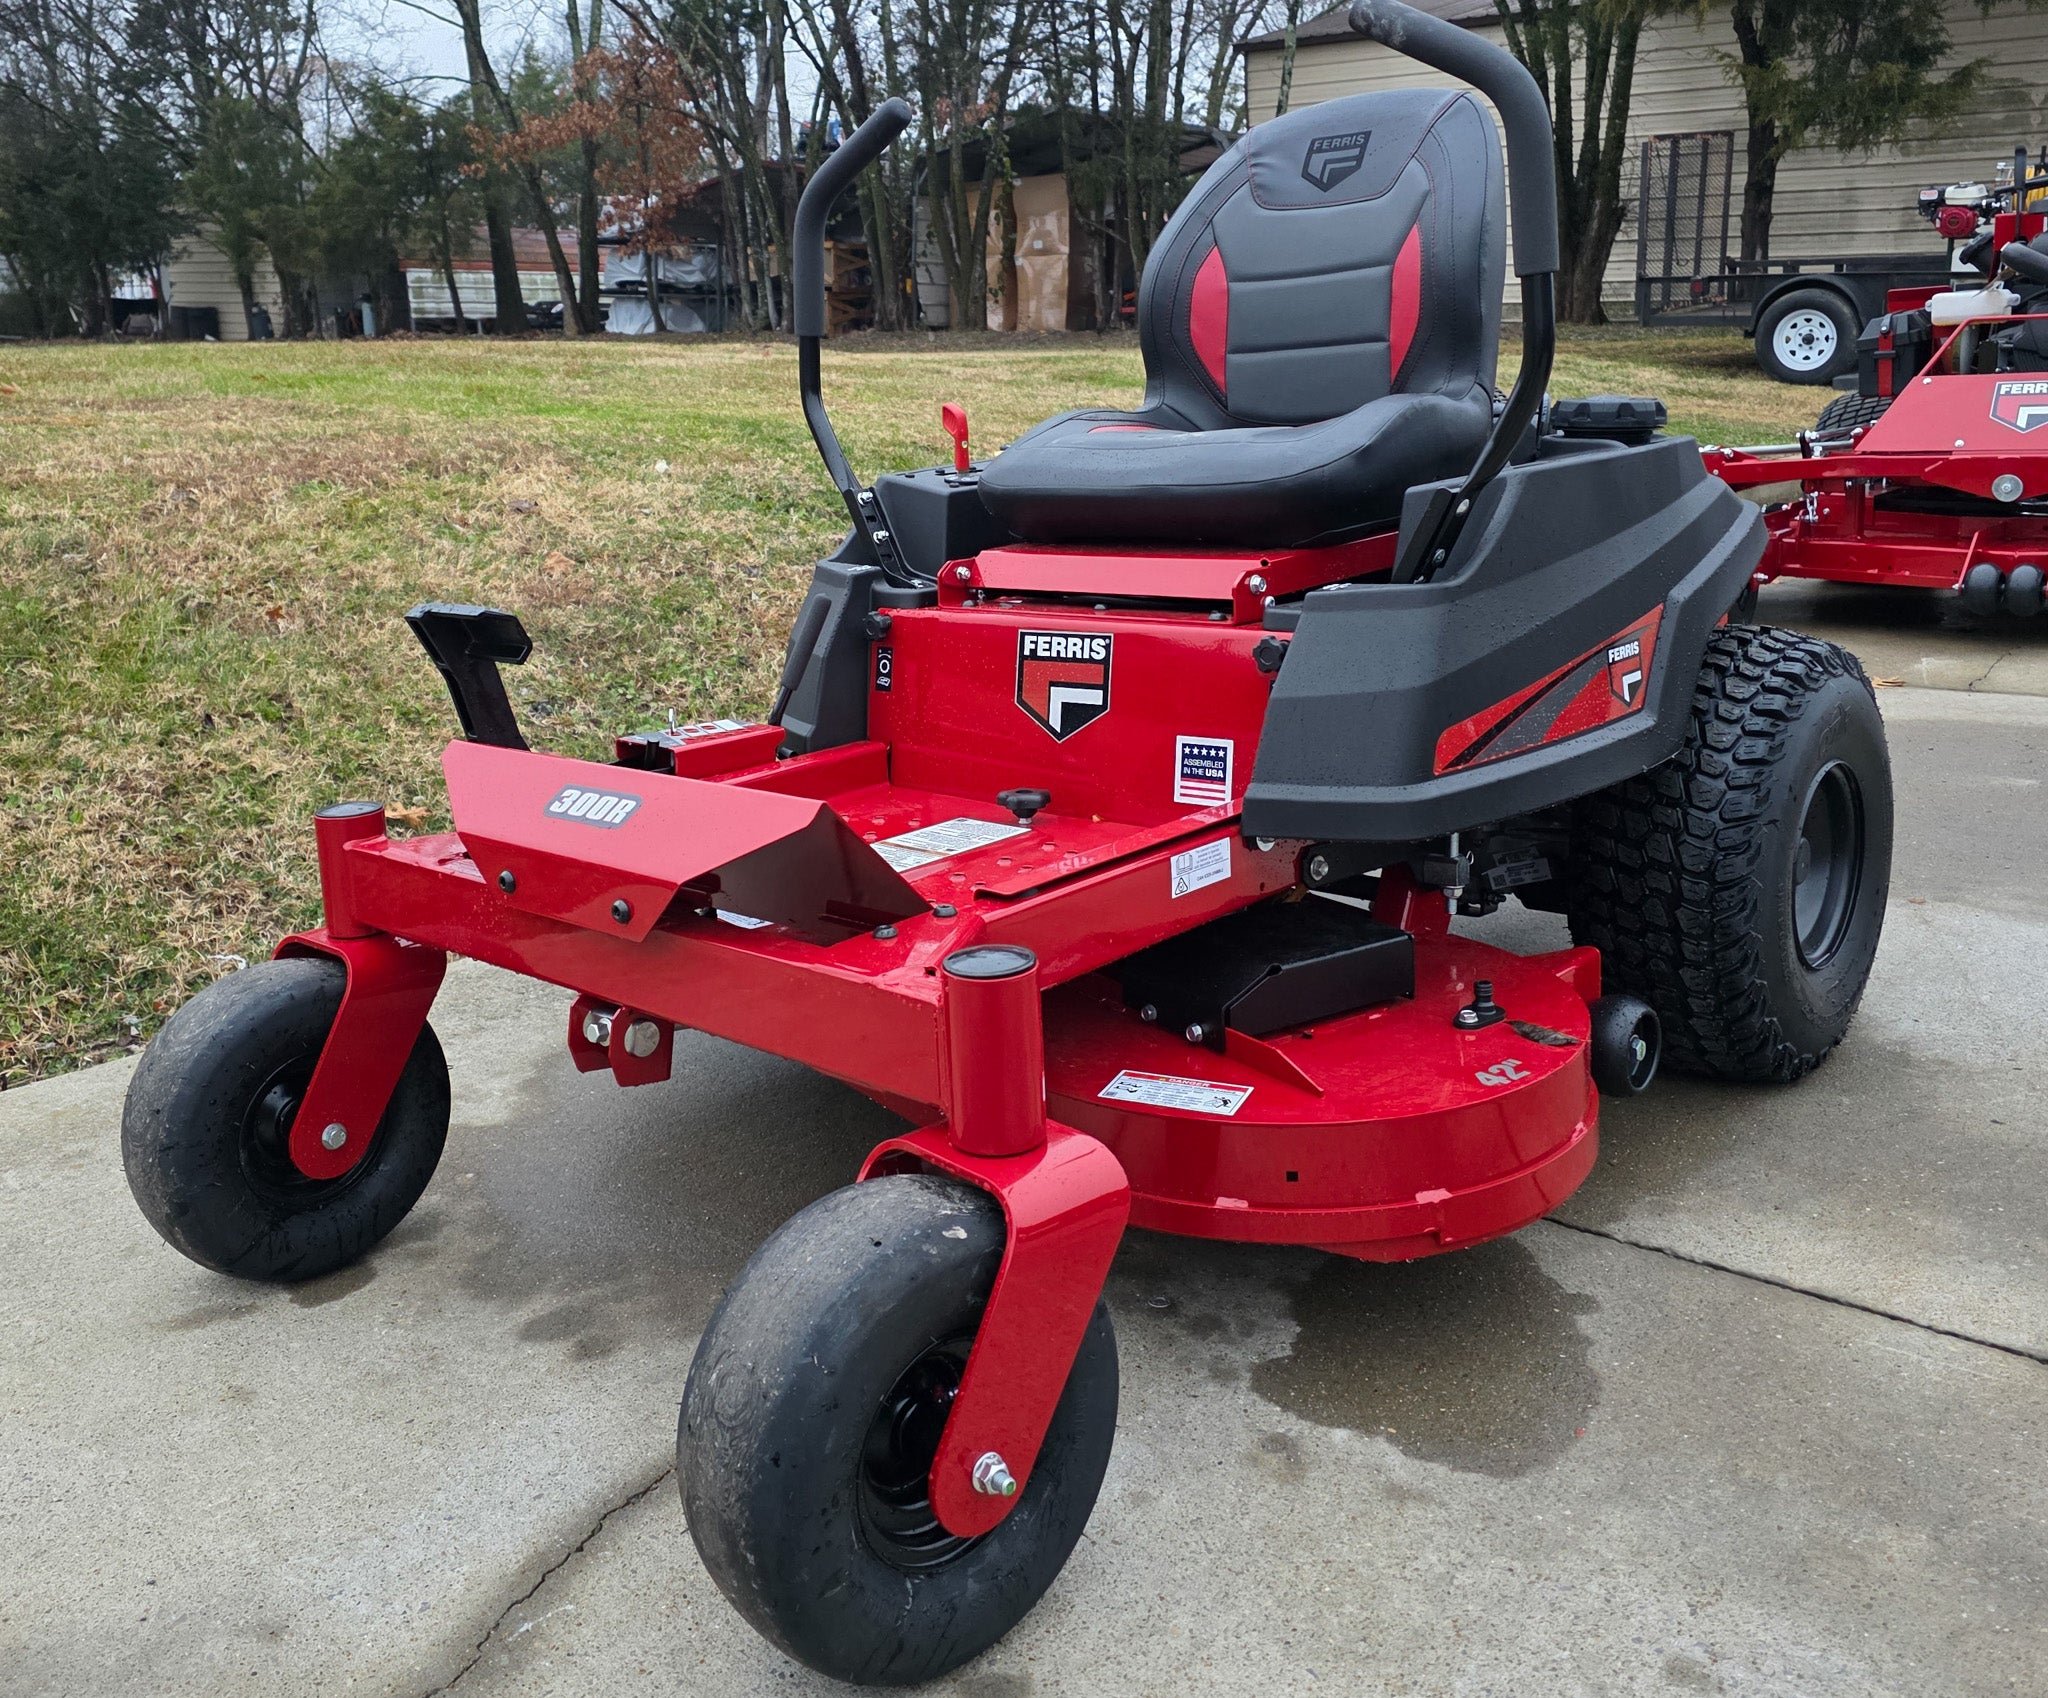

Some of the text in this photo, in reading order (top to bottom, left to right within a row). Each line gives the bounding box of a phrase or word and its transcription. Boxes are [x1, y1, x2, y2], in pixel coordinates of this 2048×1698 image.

[1313, 134, 1365, 150] FERRIS
[1023, 635, 1107, 660] FERRIS
[1608, 641, 1640, 663] FERRIS
[1183, 758, 1224, 769] ASSEMBLED
[1205, 769, 1224, 778] USA
[549, 789, 636, 824] 300R
[1168, 1078, 1211, 1087] DANGER
